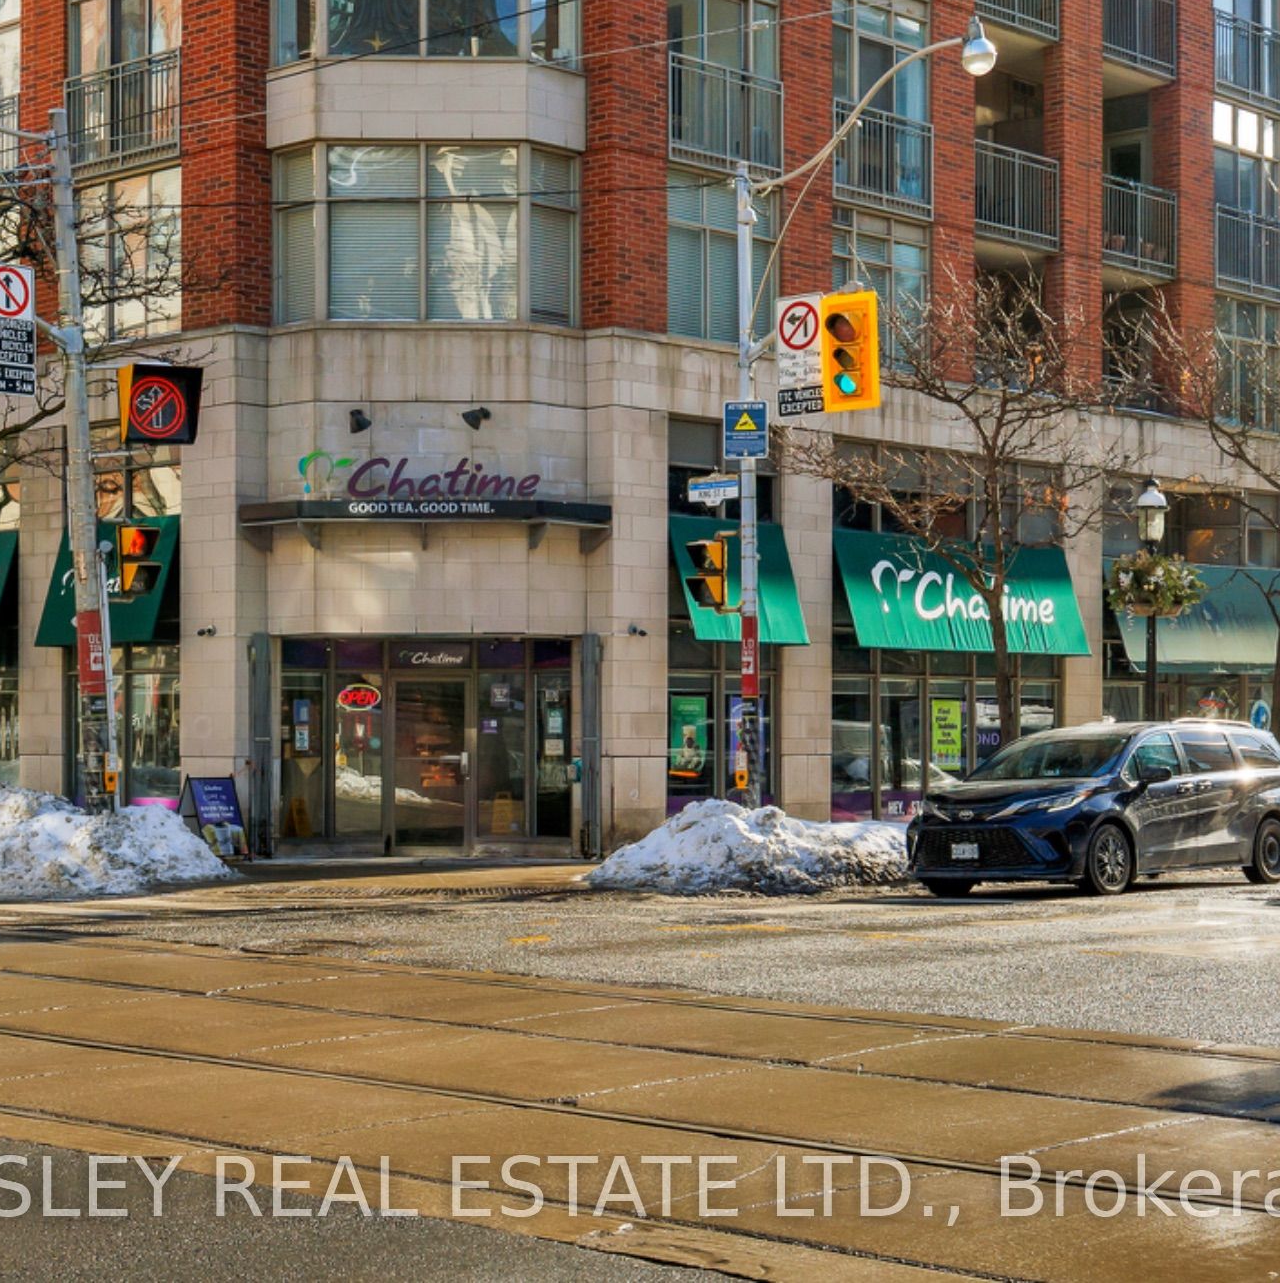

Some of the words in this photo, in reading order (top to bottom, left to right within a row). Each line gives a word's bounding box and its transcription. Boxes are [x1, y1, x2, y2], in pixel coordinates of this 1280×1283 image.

[1, 340, 34, 353] BICYCLES
[346, 456, 541, 498] Chatime
[348, 502, 387, 514] GOOD
[389, 502, 419, 514] TEA.
[420, 502, 458, 514] GOOD
[460, 502, 495, 514] TIME.
[914, 570, 1055, 624] Chaime
[411, 651, 464, 665] Chatime
[340, 689, 376, 706] OPEN
